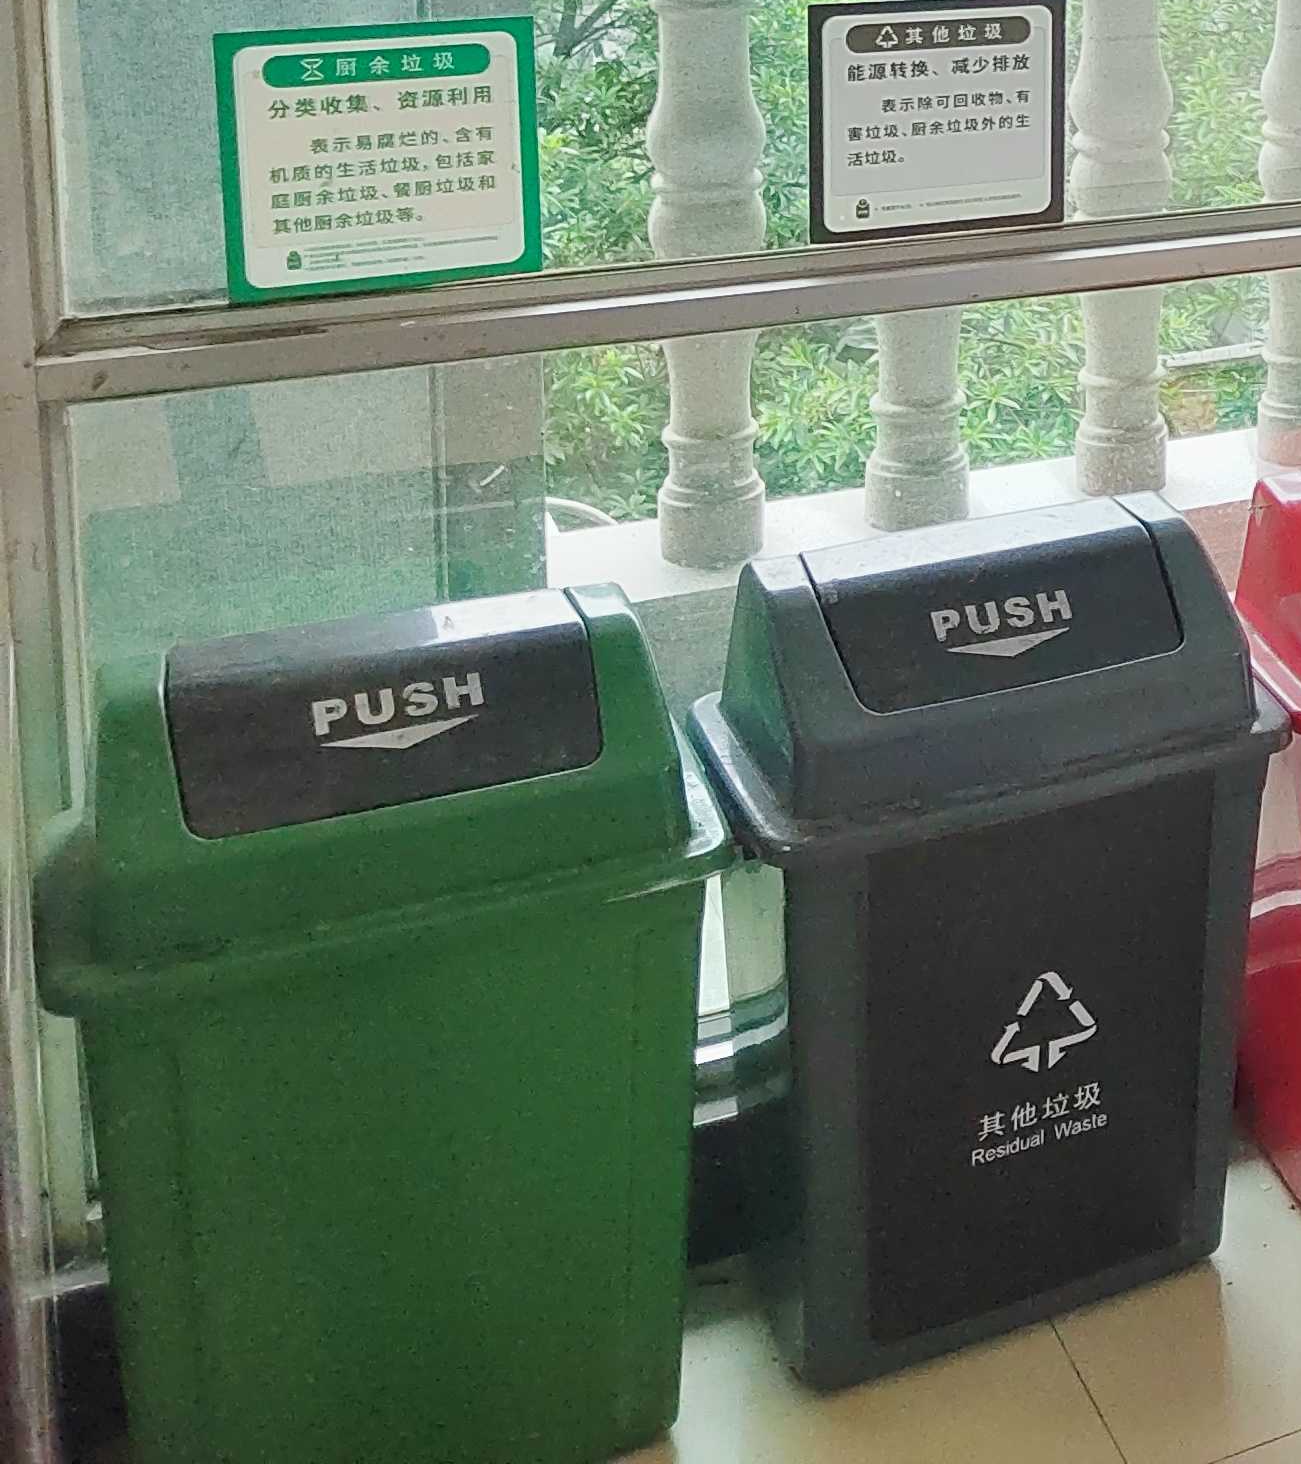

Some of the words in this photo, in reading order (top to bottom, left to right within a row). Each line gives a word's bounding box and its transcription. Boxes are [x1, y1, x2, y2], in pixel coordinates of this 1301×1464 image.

[906, 23, 1003, 45] 其他垃圾
[335, 52, 455, 77] 厨余垃圾
[848, 53, 1031, 82] 能源转换、减少排放
[268, 85, 492, 120] 分类收集、资源利用
[881, 90, 1031, 113] 表示除可回收物、有
[309, 126, 493, 154] 表示易腐烂的、含有
[848, 114, 1031, 142] 害垃圾、厨余垃圾外的生
[848, 150, 905, 167] 活垃圾。
[930, 589, 1073, 642] PUSH
[312, 672, 484, 736] PUSH
[978, 1082, 1101, 1141] 其他垃圾
[971, 1129, 1045, 1166] Residual
[1054, 1112, 1107, 1140] Waste
